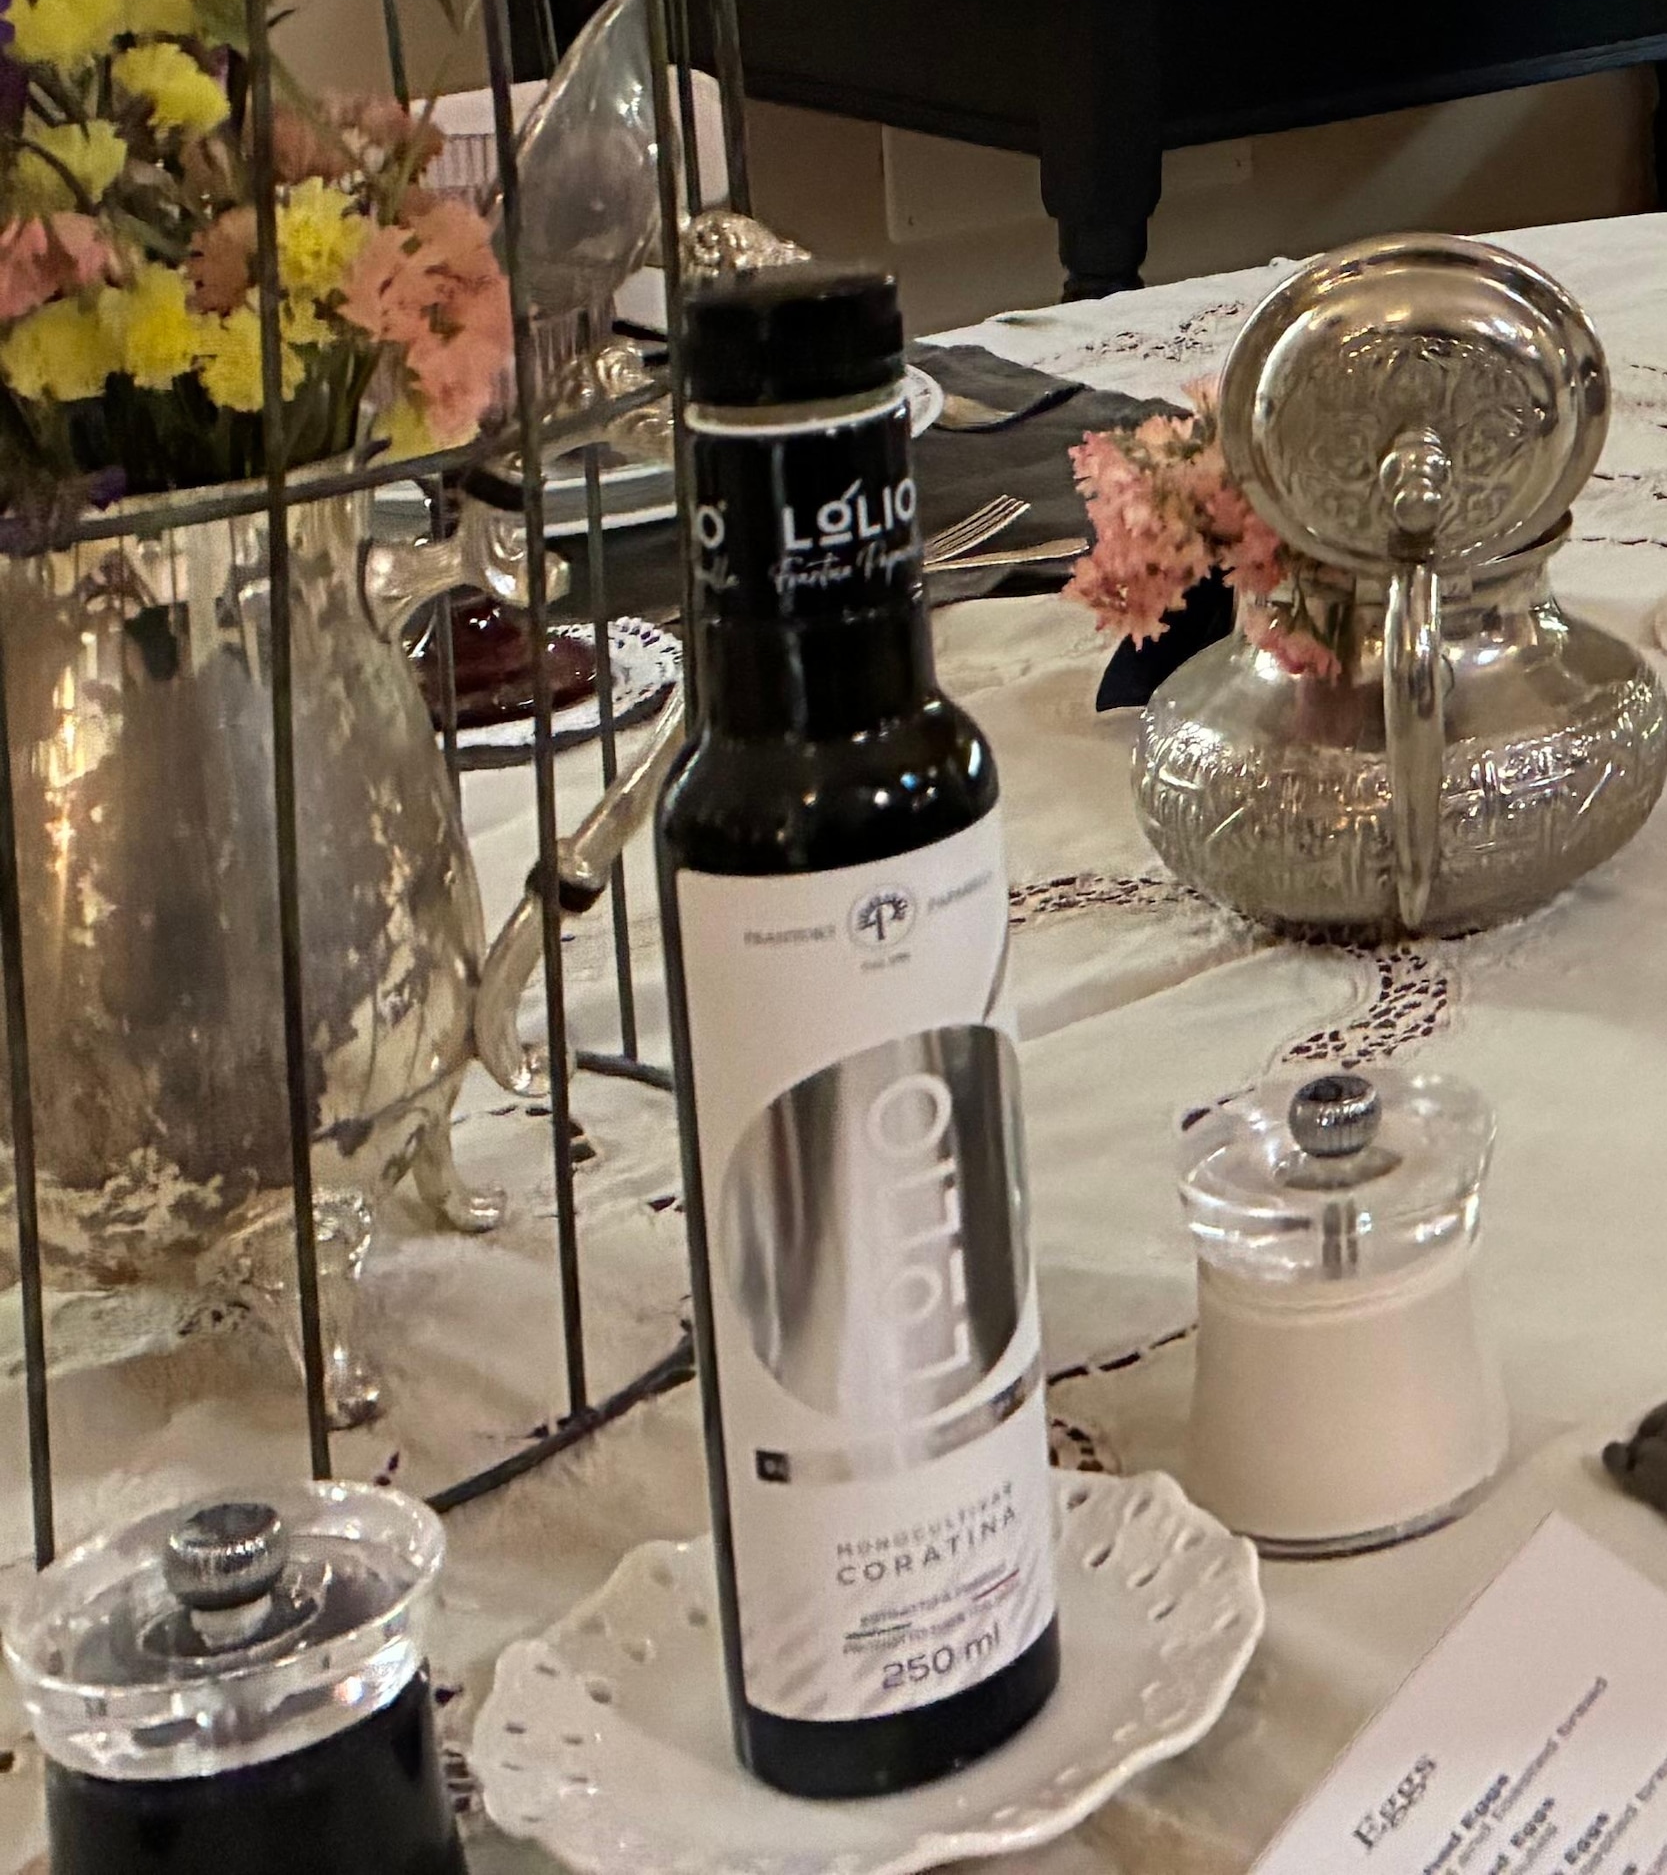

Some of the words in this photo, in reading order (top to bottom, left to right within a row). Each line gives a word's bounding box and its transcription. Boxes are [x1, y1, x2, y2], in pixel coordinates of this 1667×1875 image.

[836, 1505, 1015, 1586] CORATINA
[882, 1646, 954, 1690] 250
[965, 1621, 1000, 1660] ml
[1352, 1753, 1437, 1853] Eggs
[1460, 1773, 1510, 1831] Eggs
[1510, 1797, 1556, 1848] Eggs
[1564, 1812, 1610, 1865] Eggs
